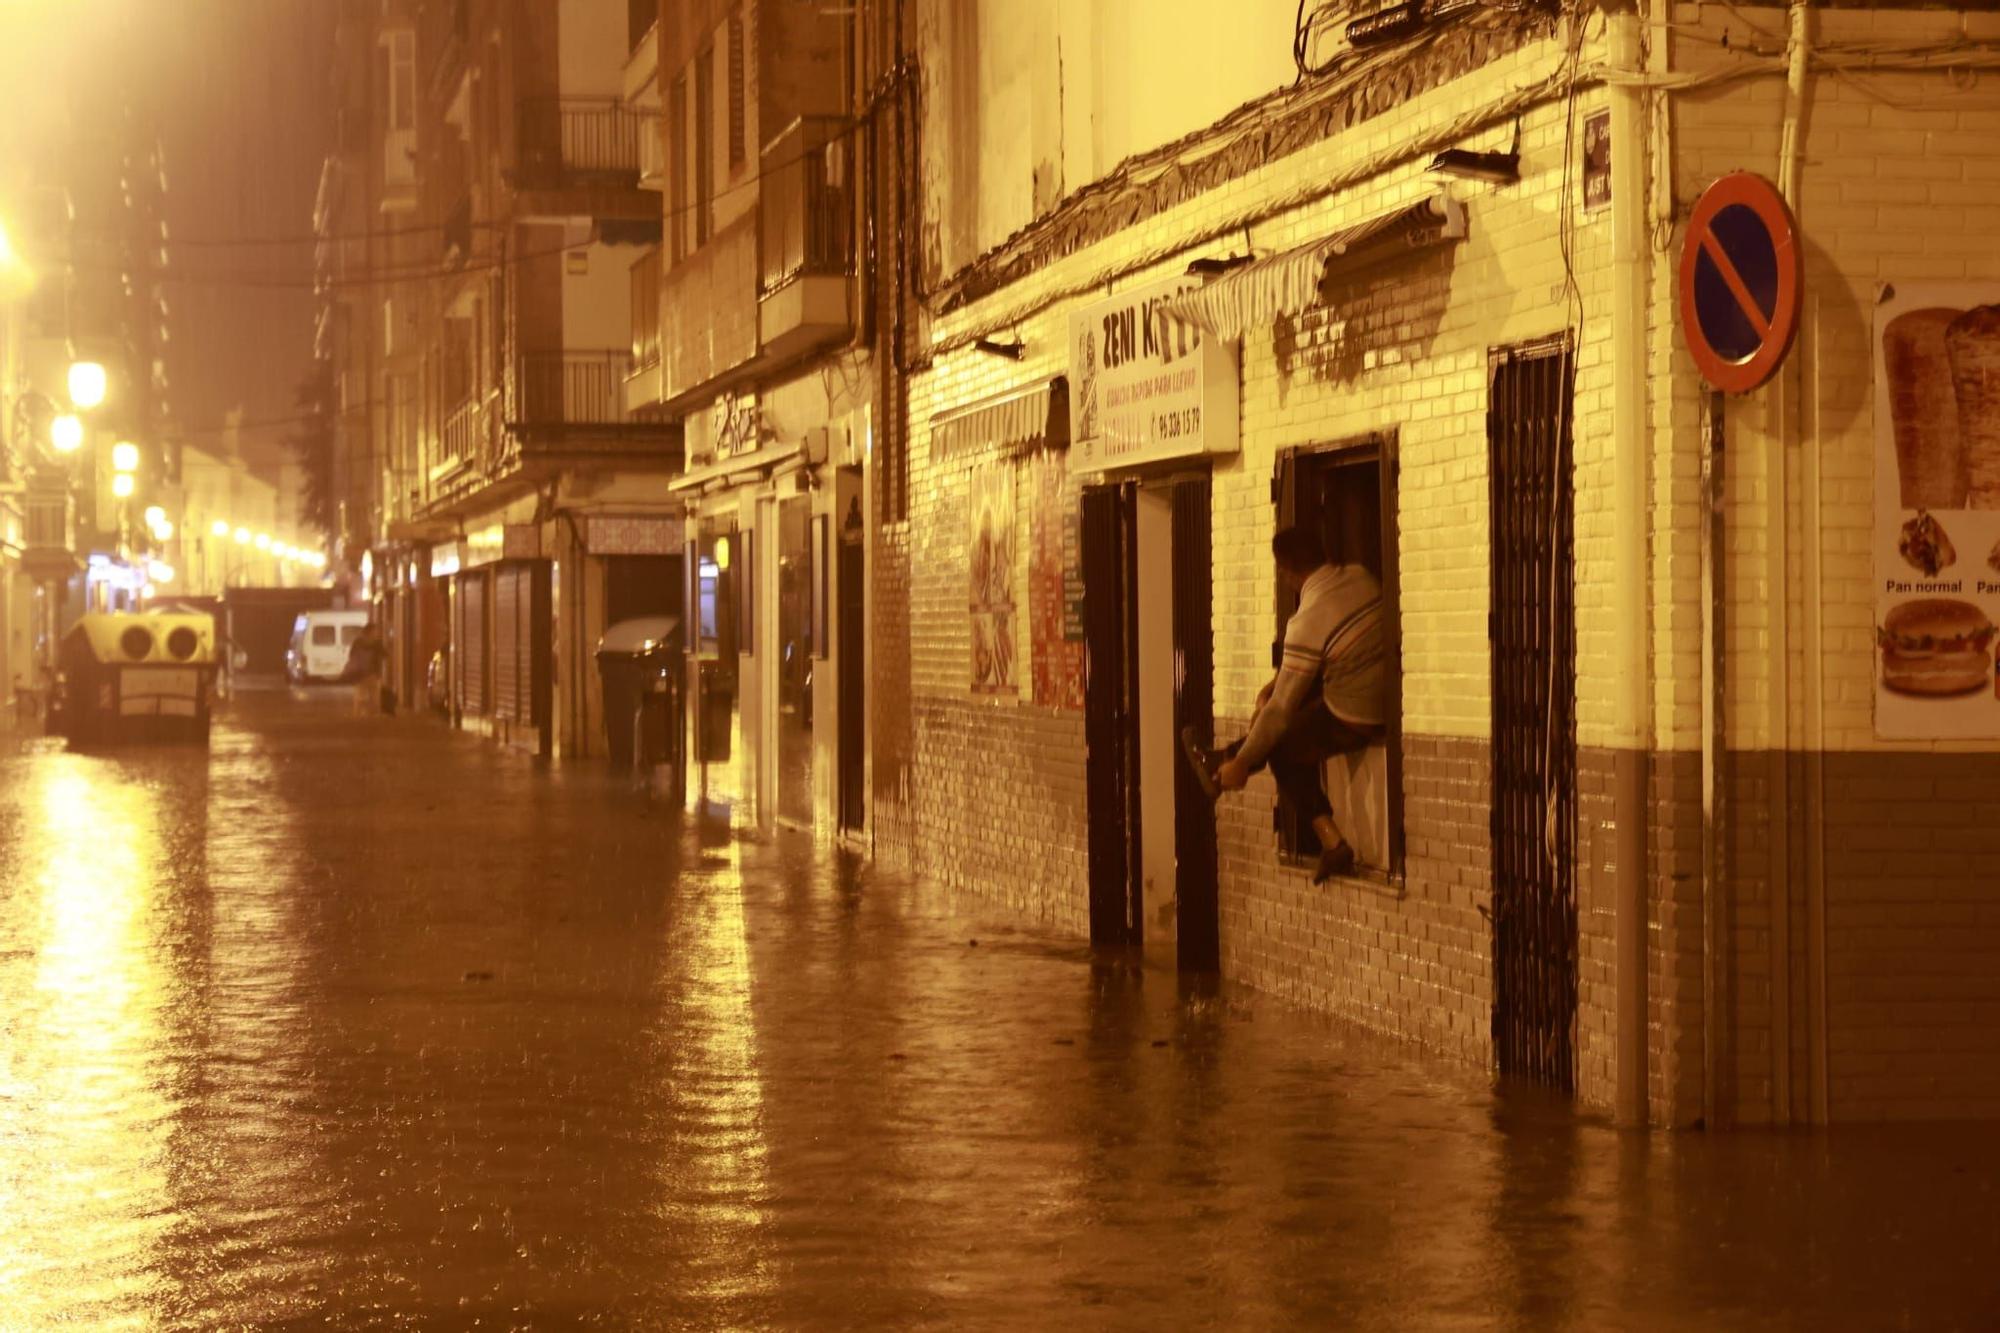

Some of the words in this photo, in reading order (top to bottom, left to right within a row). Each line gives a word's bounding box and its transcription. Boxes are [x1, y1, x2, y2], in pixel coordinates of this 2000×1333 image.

[1103, 304, 1136, 369] ZENI
[1886, 580, 1912, 593] Pan
[1916, 580, 1962, 593] normal
